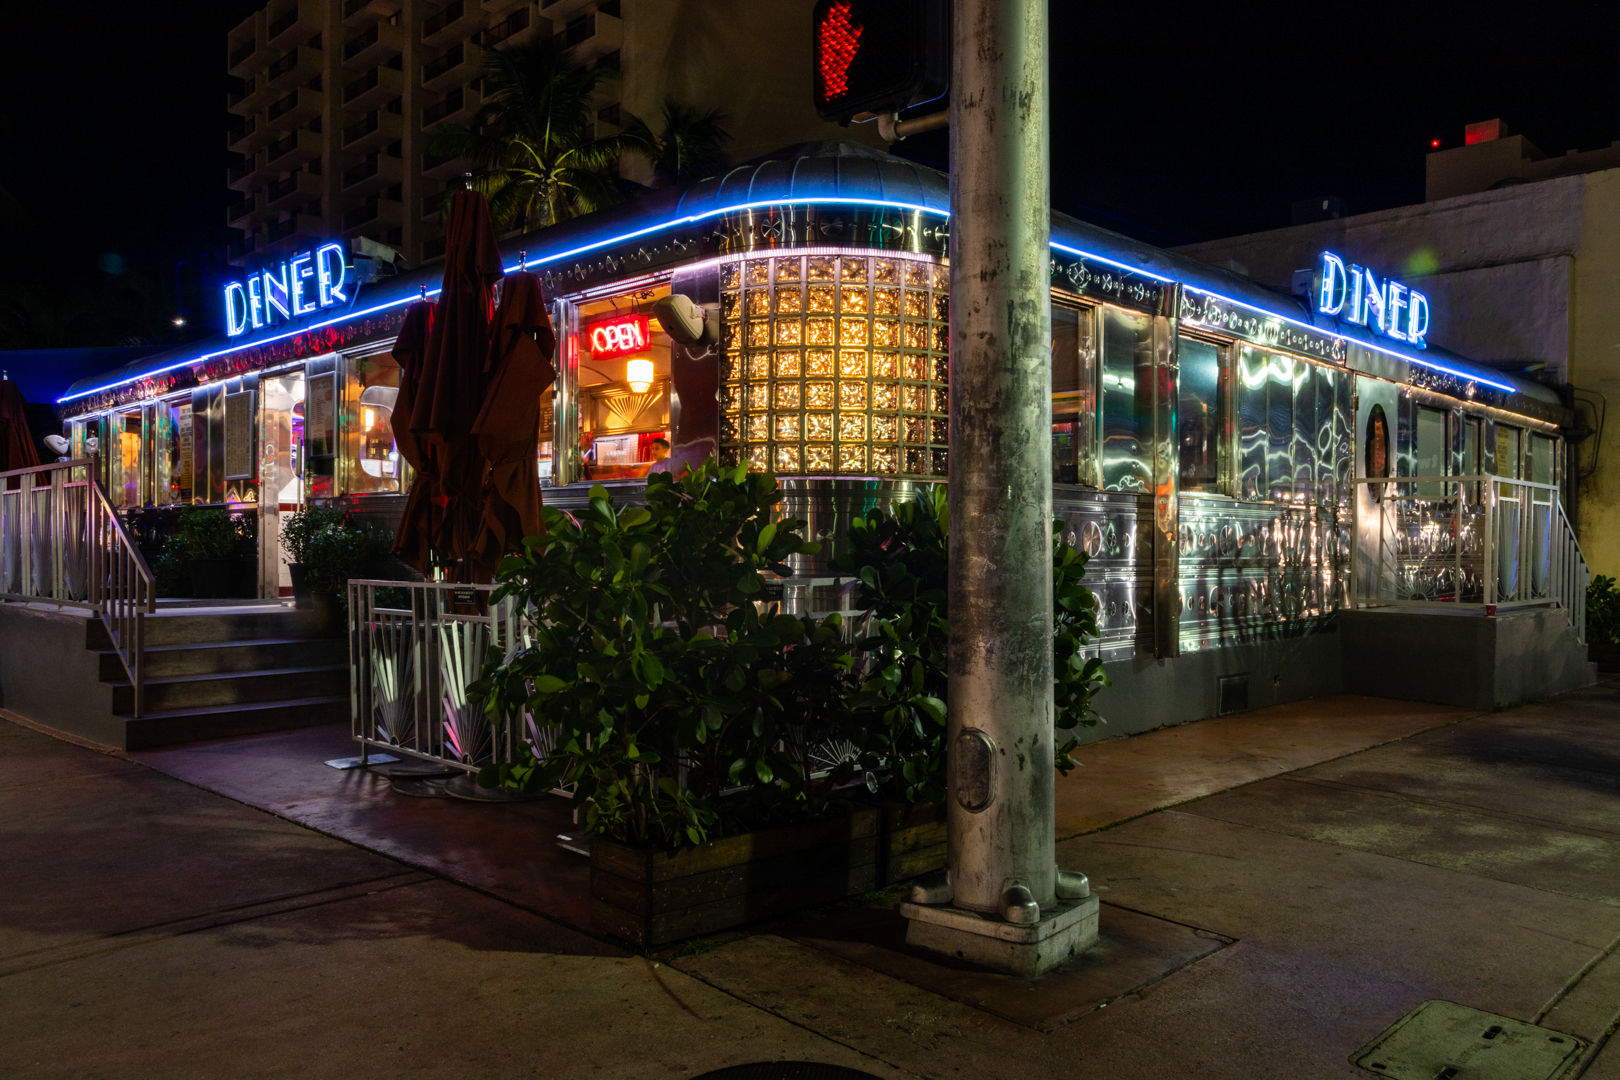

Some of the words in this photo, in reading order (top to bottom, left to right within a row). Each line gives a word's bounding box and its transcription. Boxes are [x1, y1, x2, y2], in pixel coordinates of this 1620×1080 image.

[224, 243, 346, 336] DINER
[593, 320, 644, 352] OPEN
[1320, 251, 1429, 349] DINER
